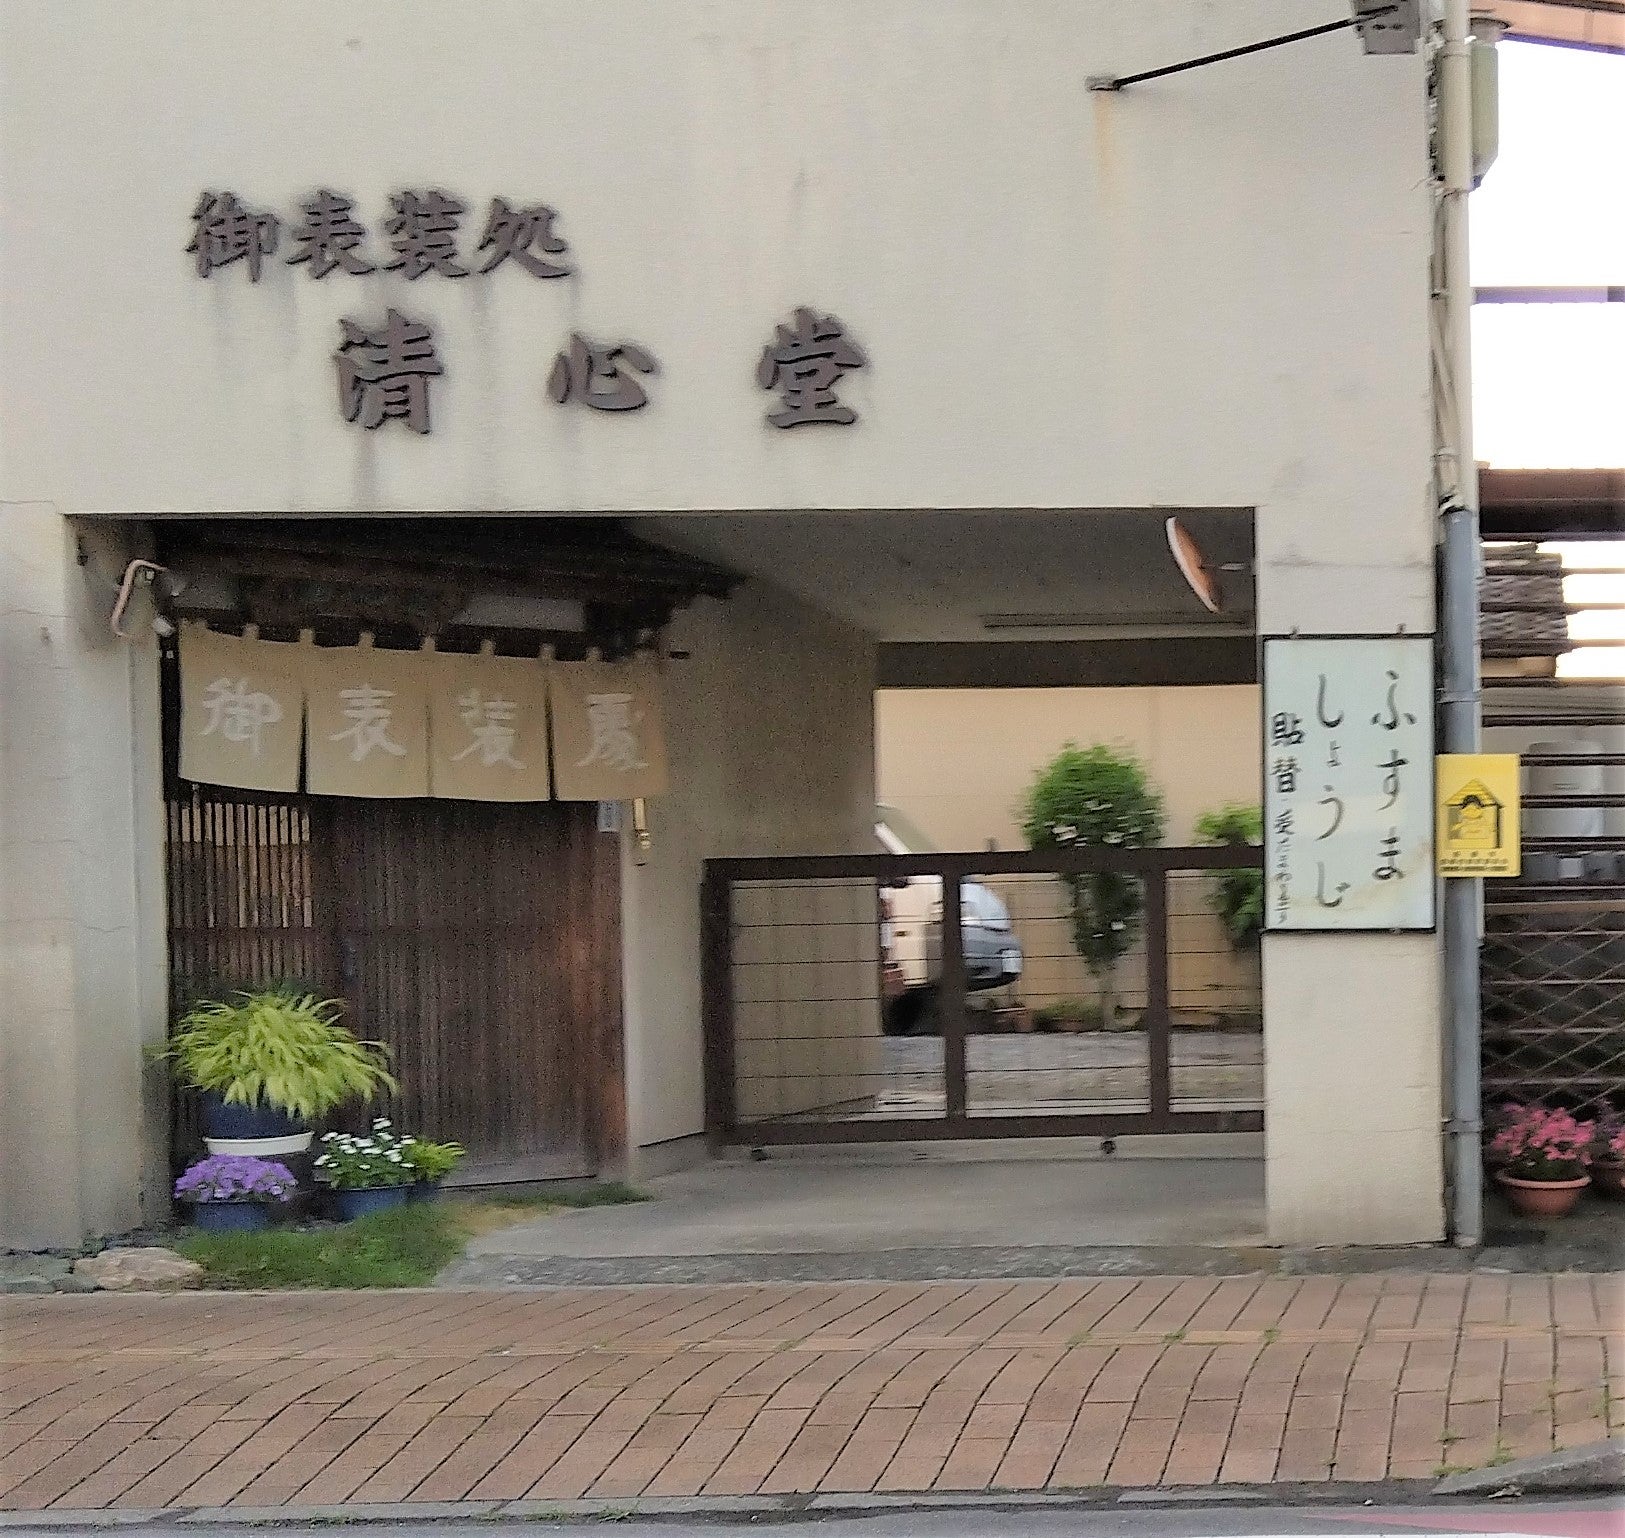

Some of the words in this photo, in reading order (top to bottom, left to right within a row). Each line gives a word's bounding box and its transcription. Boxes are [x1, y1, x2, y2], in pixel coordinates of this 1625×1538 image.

[186, 191, 571, 282] 御表装処
[333, 308, 866, 434] 清心堂
[1271, 711, 1306, 793] 貼替
[1315, 672, 1351, 908] しょうじ
[1370, 669, 1418, 881] ふすま
